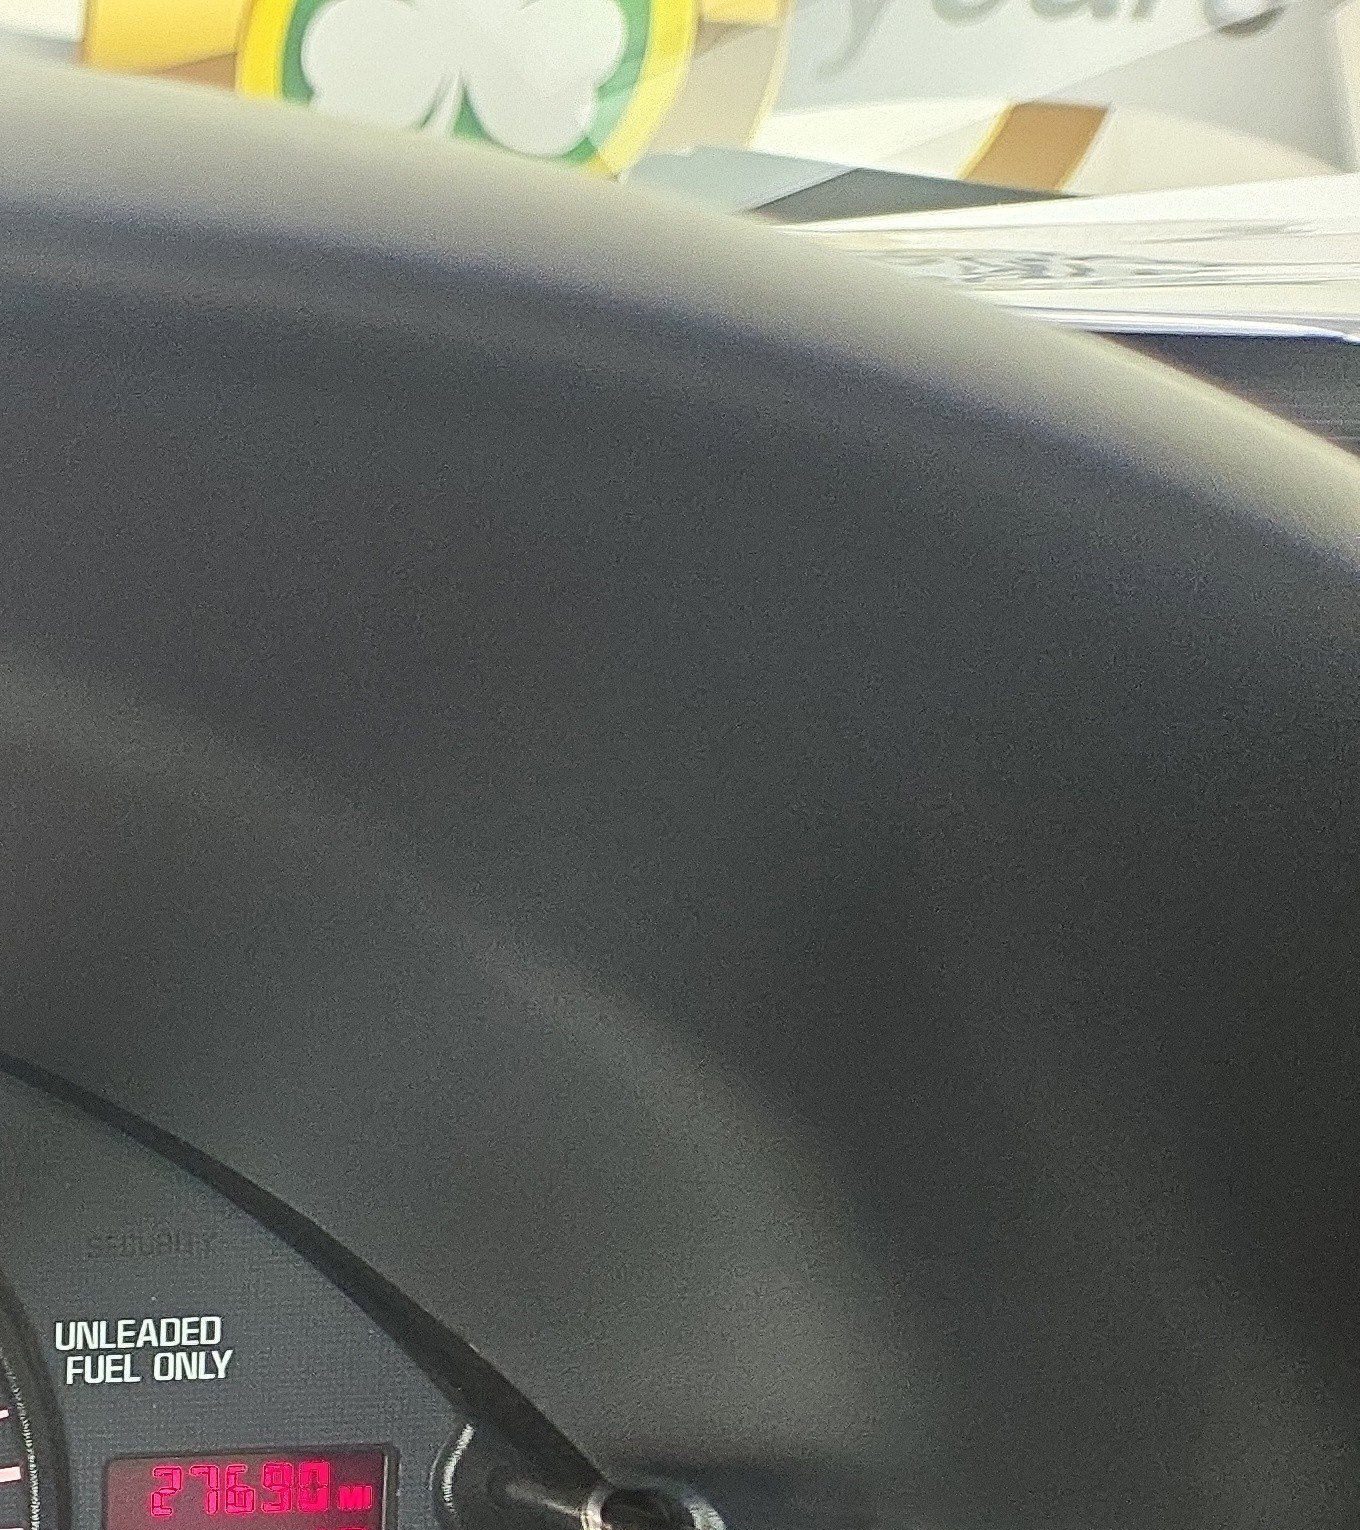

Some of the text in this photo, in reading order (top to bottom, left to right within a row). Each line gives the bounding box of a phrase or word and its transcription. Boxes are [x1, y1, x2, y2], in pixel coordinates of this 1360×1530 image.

[56, 1317, 221, 1350] UNLEADED
[66, 1349, 232, 1385] FUEL ONLY
[150, 1463, 330, 1517] 27690
